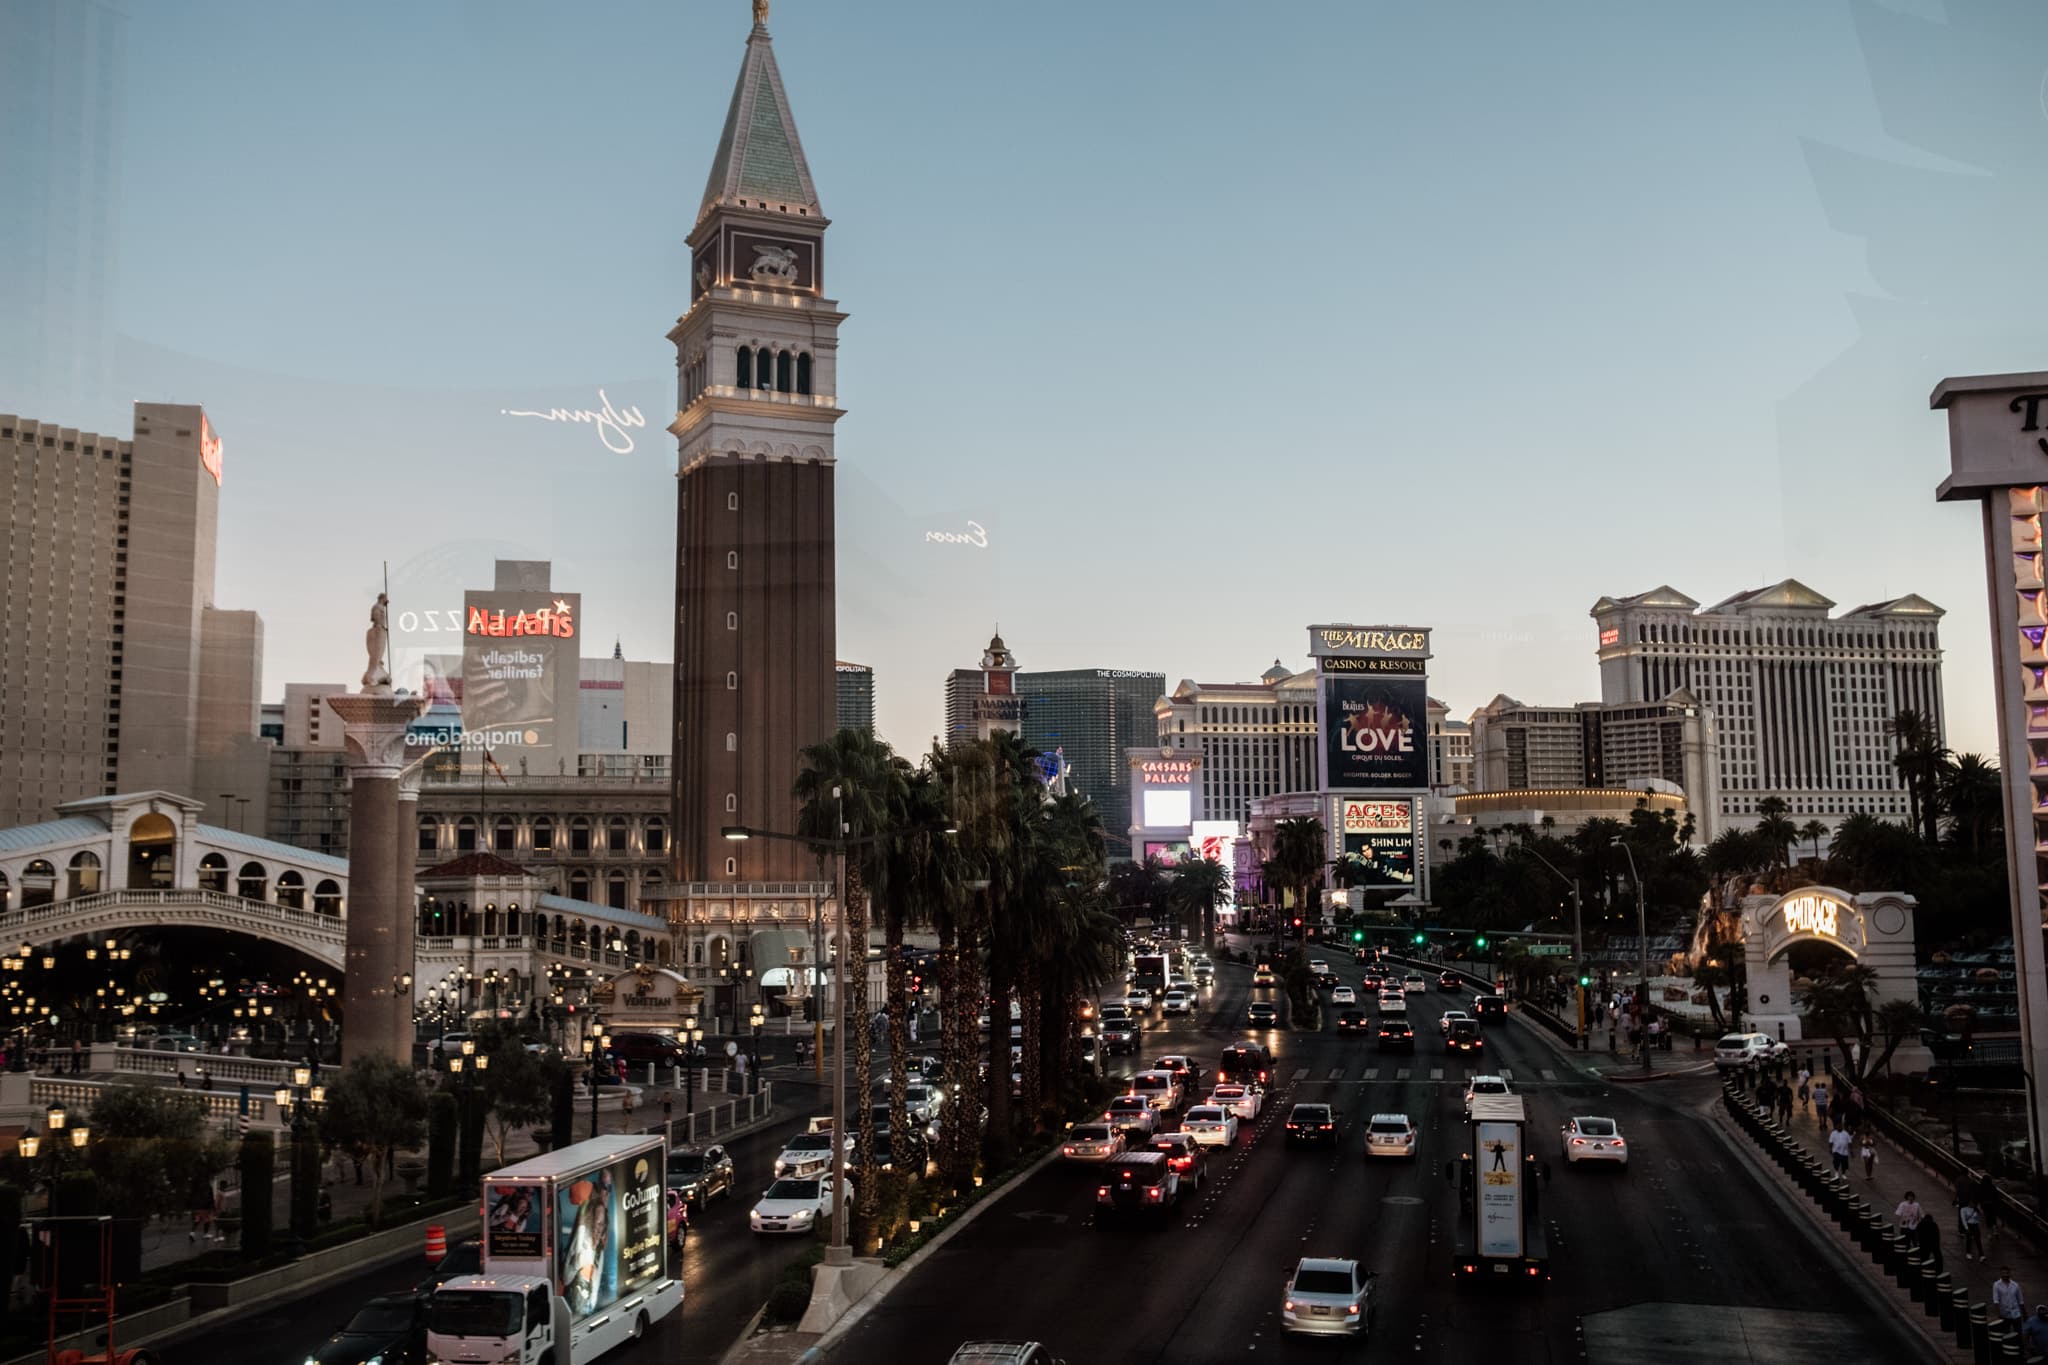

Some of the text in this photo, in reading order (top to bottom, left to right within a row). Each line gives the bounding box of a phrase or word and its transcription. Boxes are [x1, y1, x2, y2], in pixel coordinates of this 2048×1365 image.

[1320, 630, 1425, 652] THE MIRAGE
[1324, 659, 1424, 671] CASINO & RESORT
[1096, 670, 1165, 679] THE COSMOPOLITAN
[1342, 700, 1365, 712] BEATLES
[1341, 727, 1414, 752] LOVE
[1141, 762, 1193, 773] CAESARS
[1144, 774, 1191, 784] PALACE
[1345, 804, 1410, 819] ACES
[1345, 819, 1410, 829] COMEDY
[1371, 837, 1412, 847] SHIN LIM
[1792, 896, 1837, 937] MIRAGE
[622, 1183, 660, 1211] GoJump
